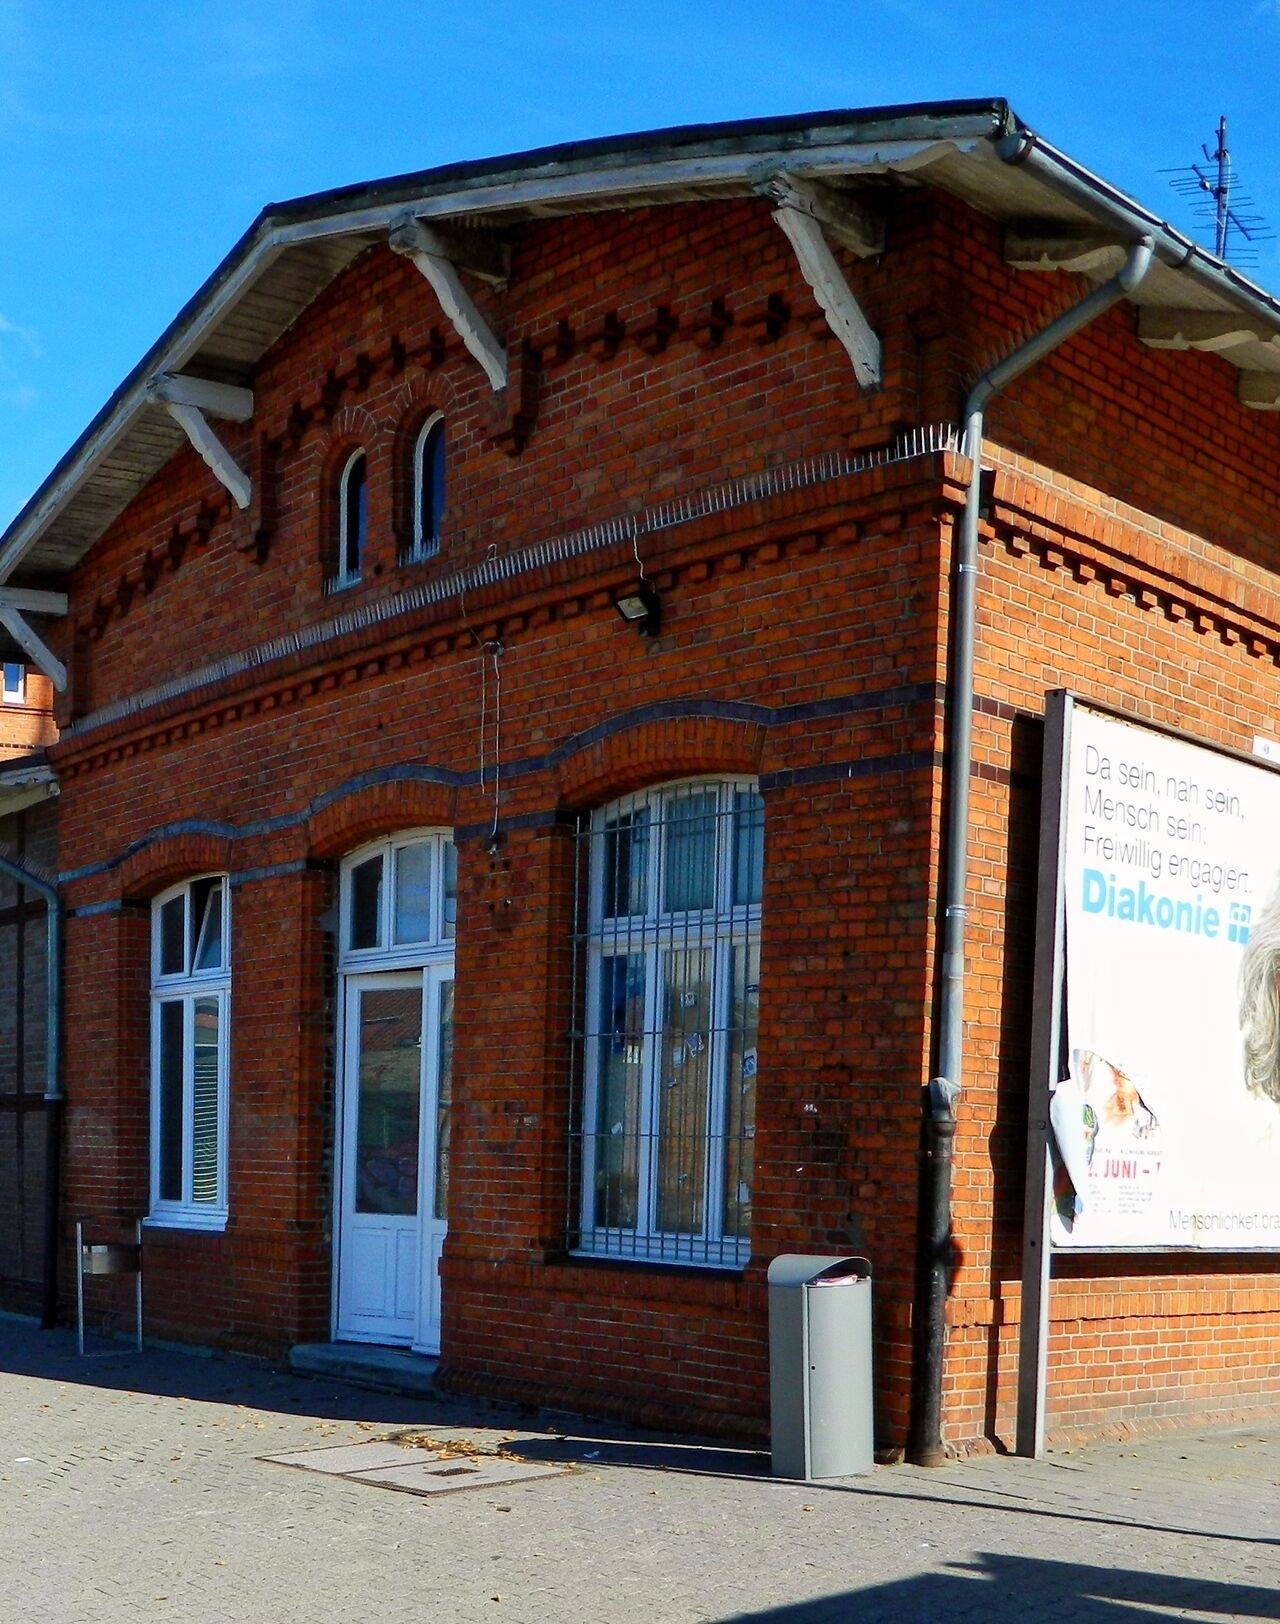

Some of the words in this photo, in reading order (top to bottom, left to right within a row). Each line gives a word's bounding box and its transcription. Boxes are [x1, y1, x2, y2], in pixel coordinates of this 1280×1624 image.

[1084, 785, 1160, 833] Mensch
[1085, 745, 1111, 780] Da
[1118, 762, 1161, 799] sein,
[1166, 776, 1199, 805] nah
[1205, 787, 1246, 824] sein,
[1083, 825, 1162, 879] Freiwillig
[1082, 868, 1220, 938] Diakonie
[1103, 1159, 1138, 1179] JUNI
